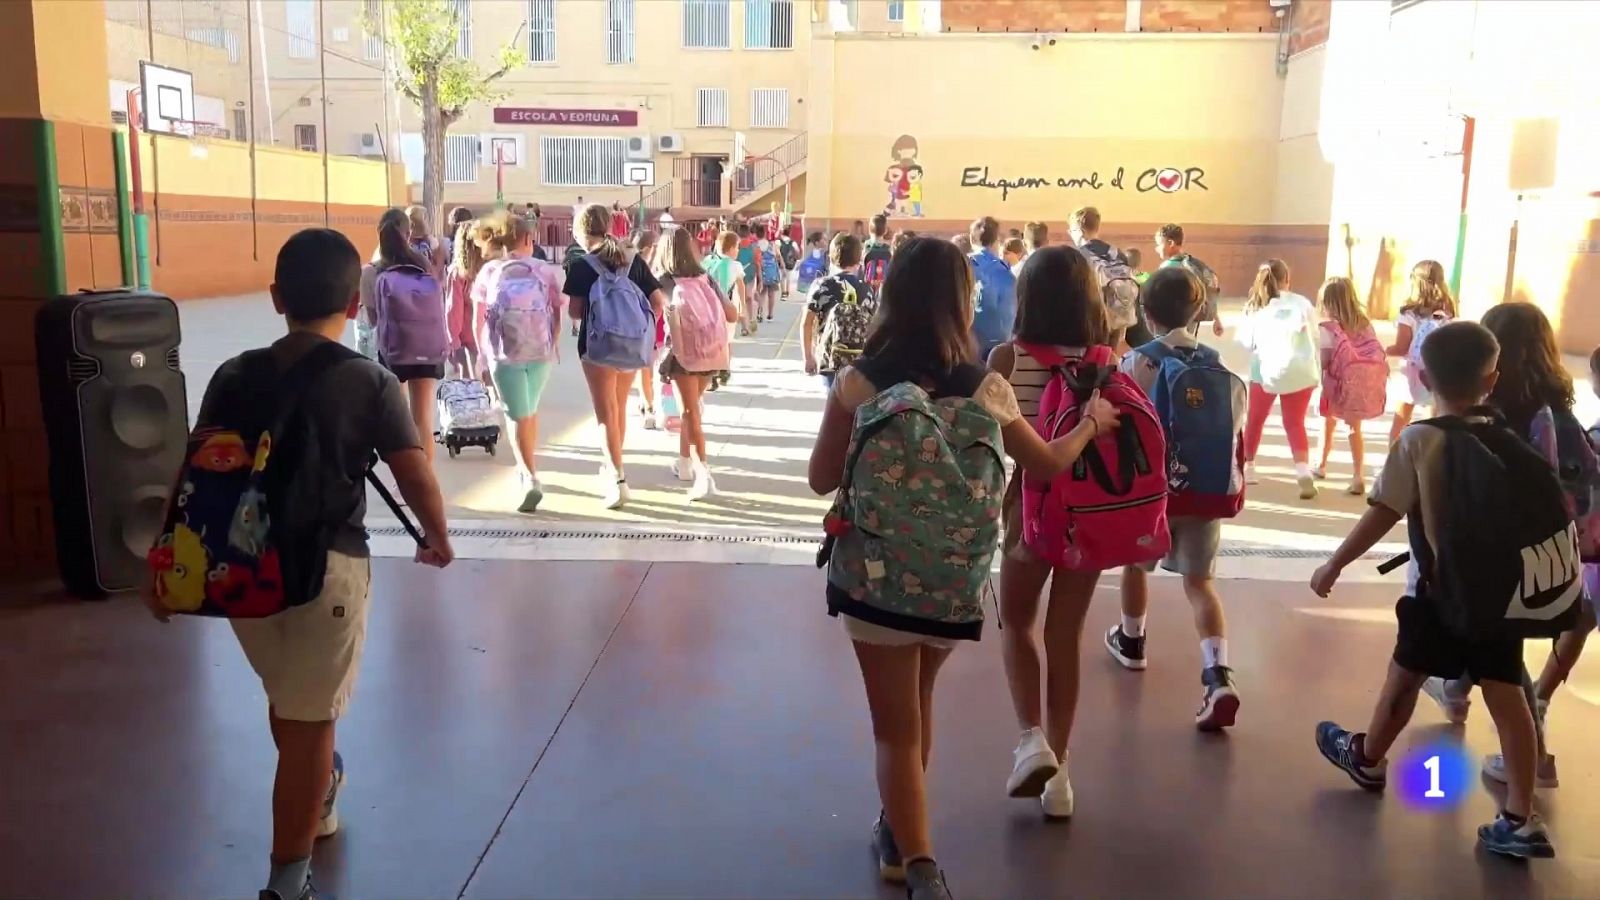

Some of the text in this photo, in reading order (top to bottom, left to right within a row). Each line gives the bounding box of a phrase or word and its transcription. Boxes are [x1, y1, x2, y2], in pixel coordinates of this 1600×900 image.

[510, 110, 620, 123] ESCOLA VEDRUNA
[960, 166, 1209, 202] Eduquem amb el COR
[1520, 520, 1581, 599] NIK
